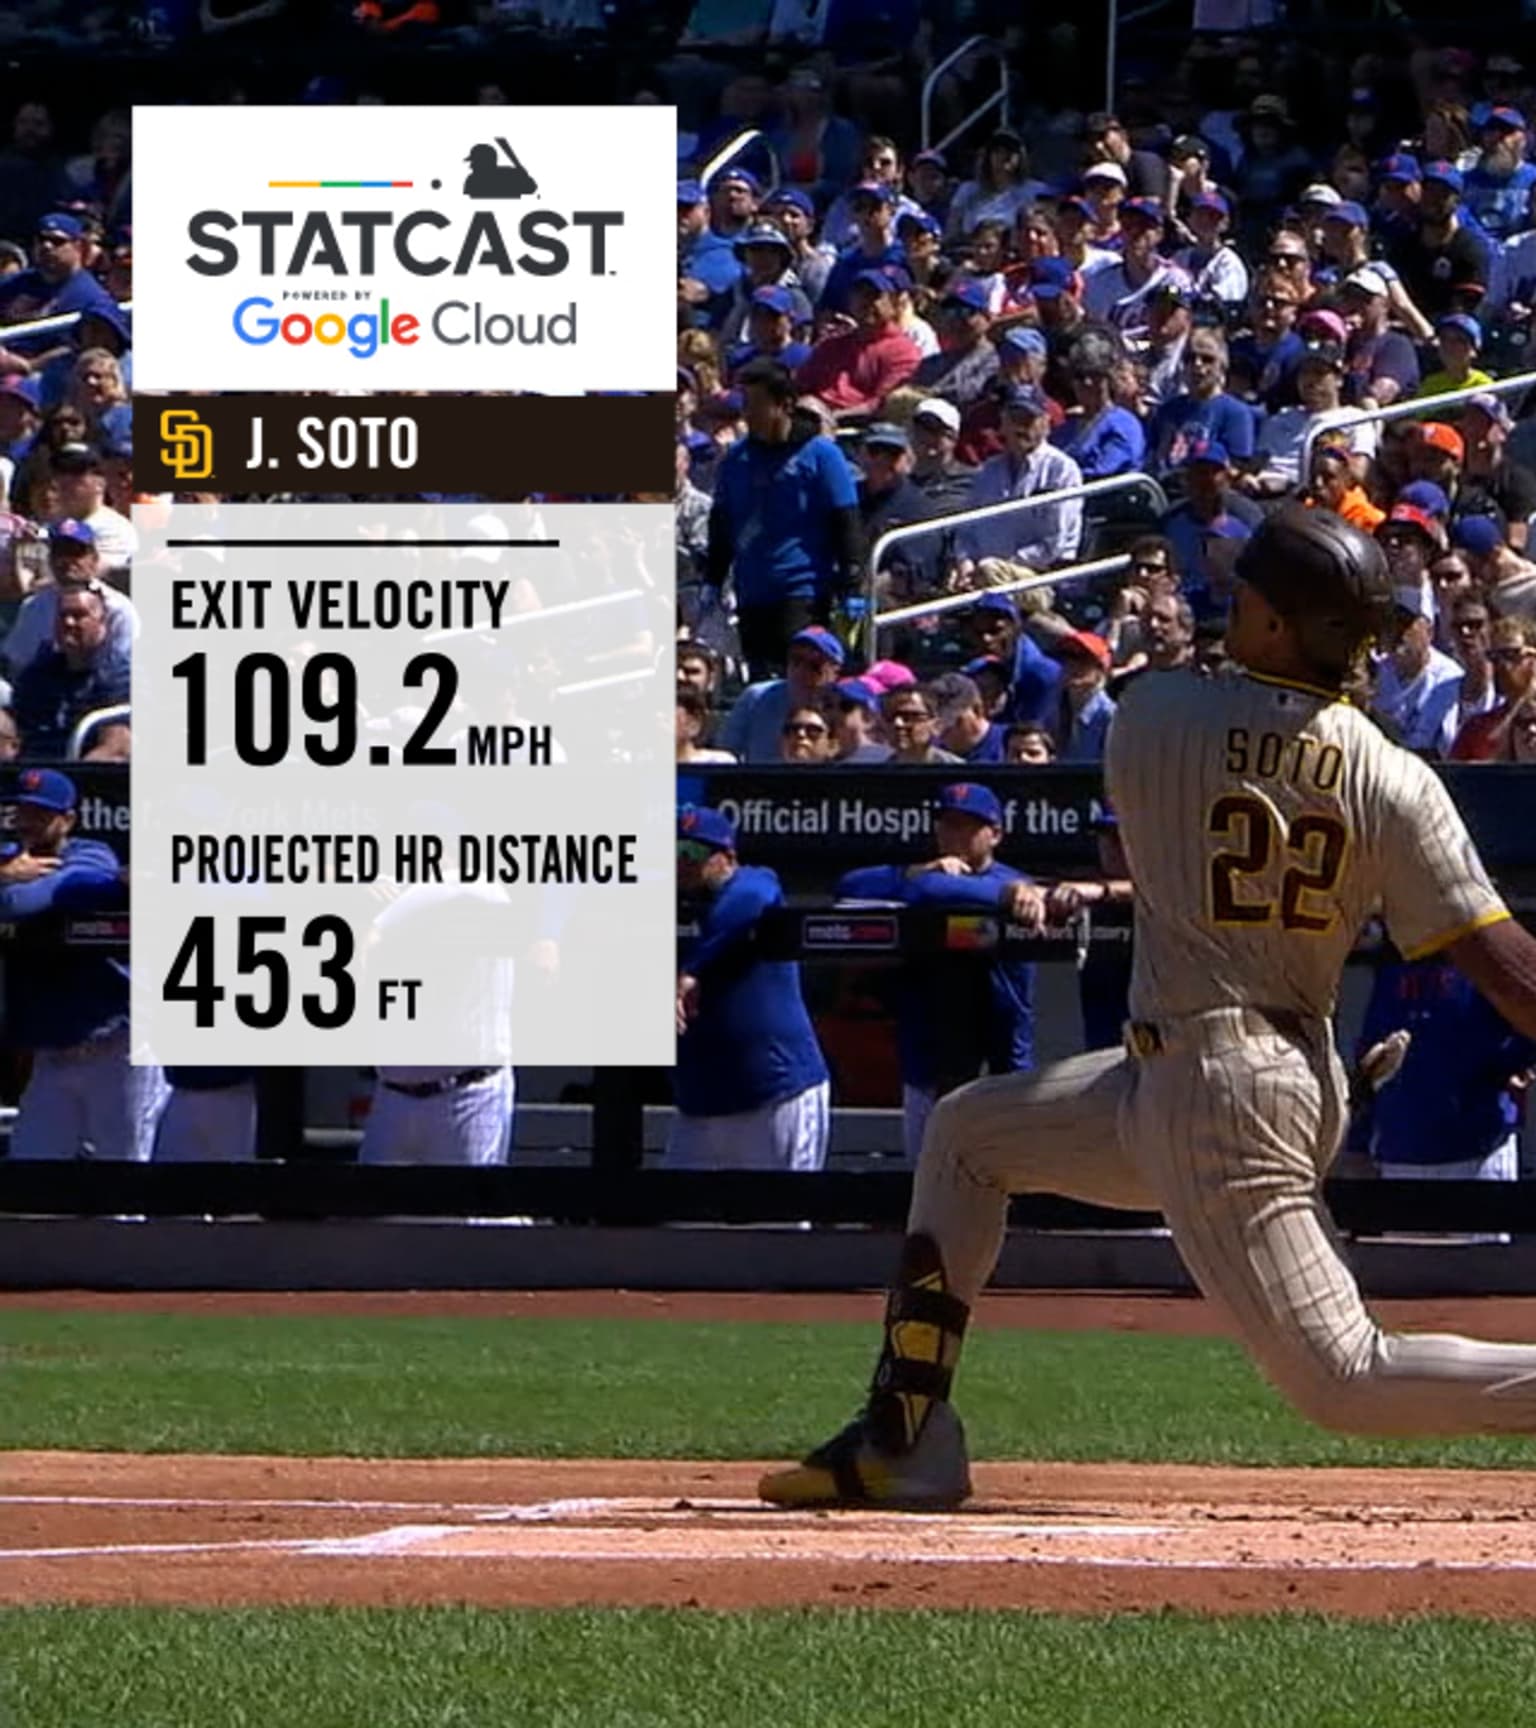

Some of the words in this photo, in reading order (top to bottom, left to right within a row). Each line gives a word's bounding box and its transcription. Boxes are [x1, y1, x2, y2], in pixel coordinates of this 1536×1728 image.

[1226, 729, 1344, 781] SOTO
[80, 798, 130, 831] the
[717, 799, 828, 834] Official
[838, 800, 941, 842] Hospi
[1026, 799, 1079, 834] the
[1207, 793, 1347, 934] 22
